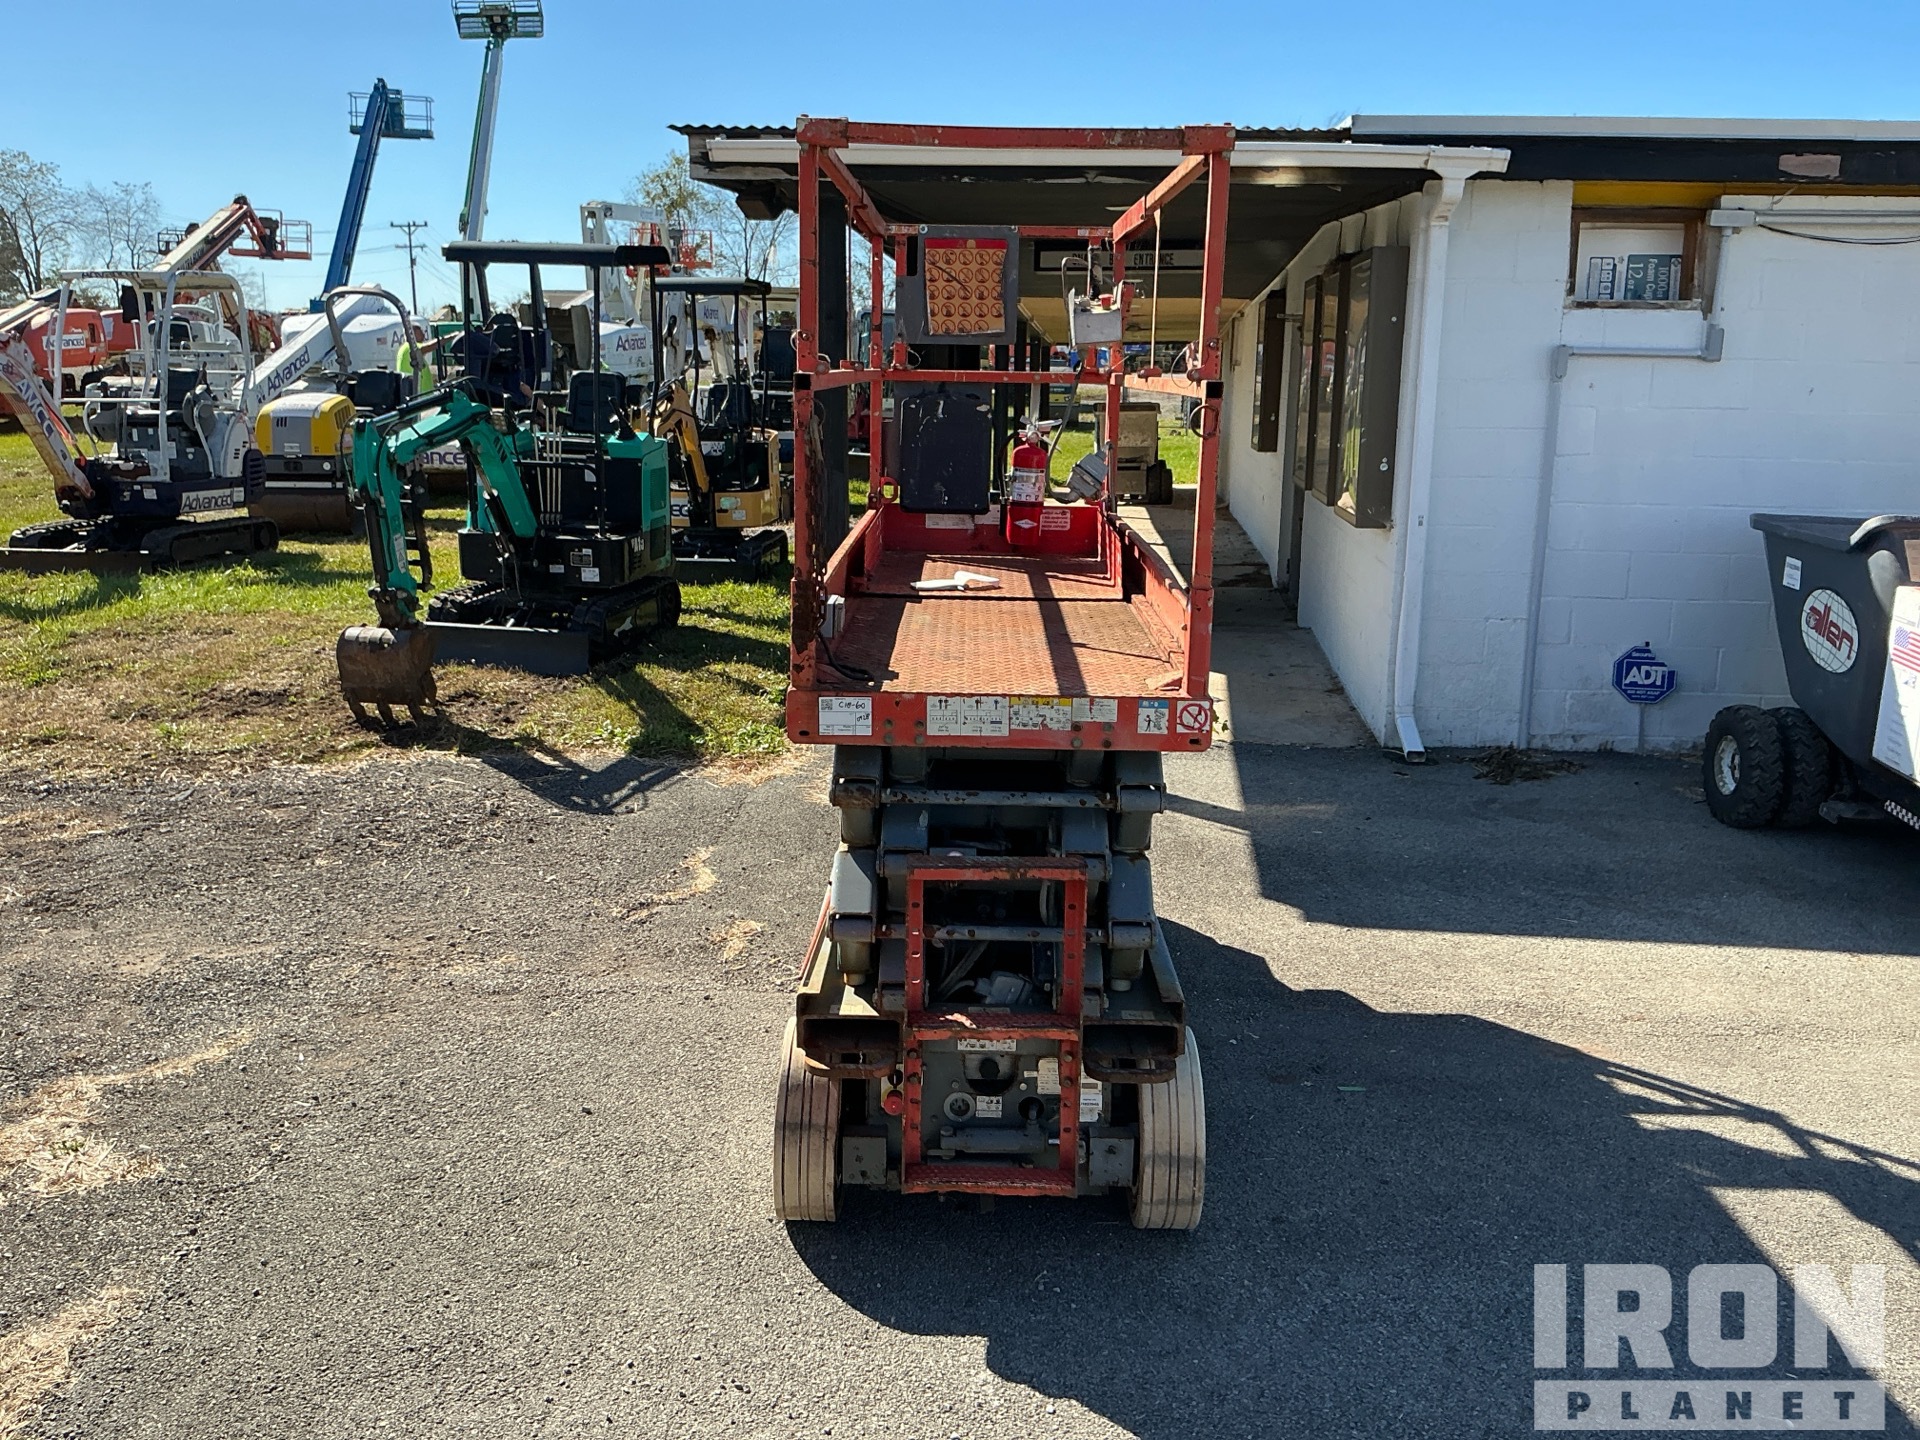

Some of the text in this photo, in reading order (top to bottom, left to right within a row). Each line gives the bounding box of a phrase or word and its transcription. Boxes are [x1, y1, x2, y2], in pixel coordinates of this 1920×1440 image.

[1133, 253, 1174, 266] ENTRNCE
[1646, 258, 1658, 281] Foam
[1628, 263, 1644, 279] 12
[44, 336, 85, 349] Aanced
[616, 334, 647, 352] Advanced
[267, 345, 310, 396] Advanced
[182, 491, 233, 511] Advanced
[1805, 603, 1854, 661] allen
[1624, 665, 1667, 685] ADT
